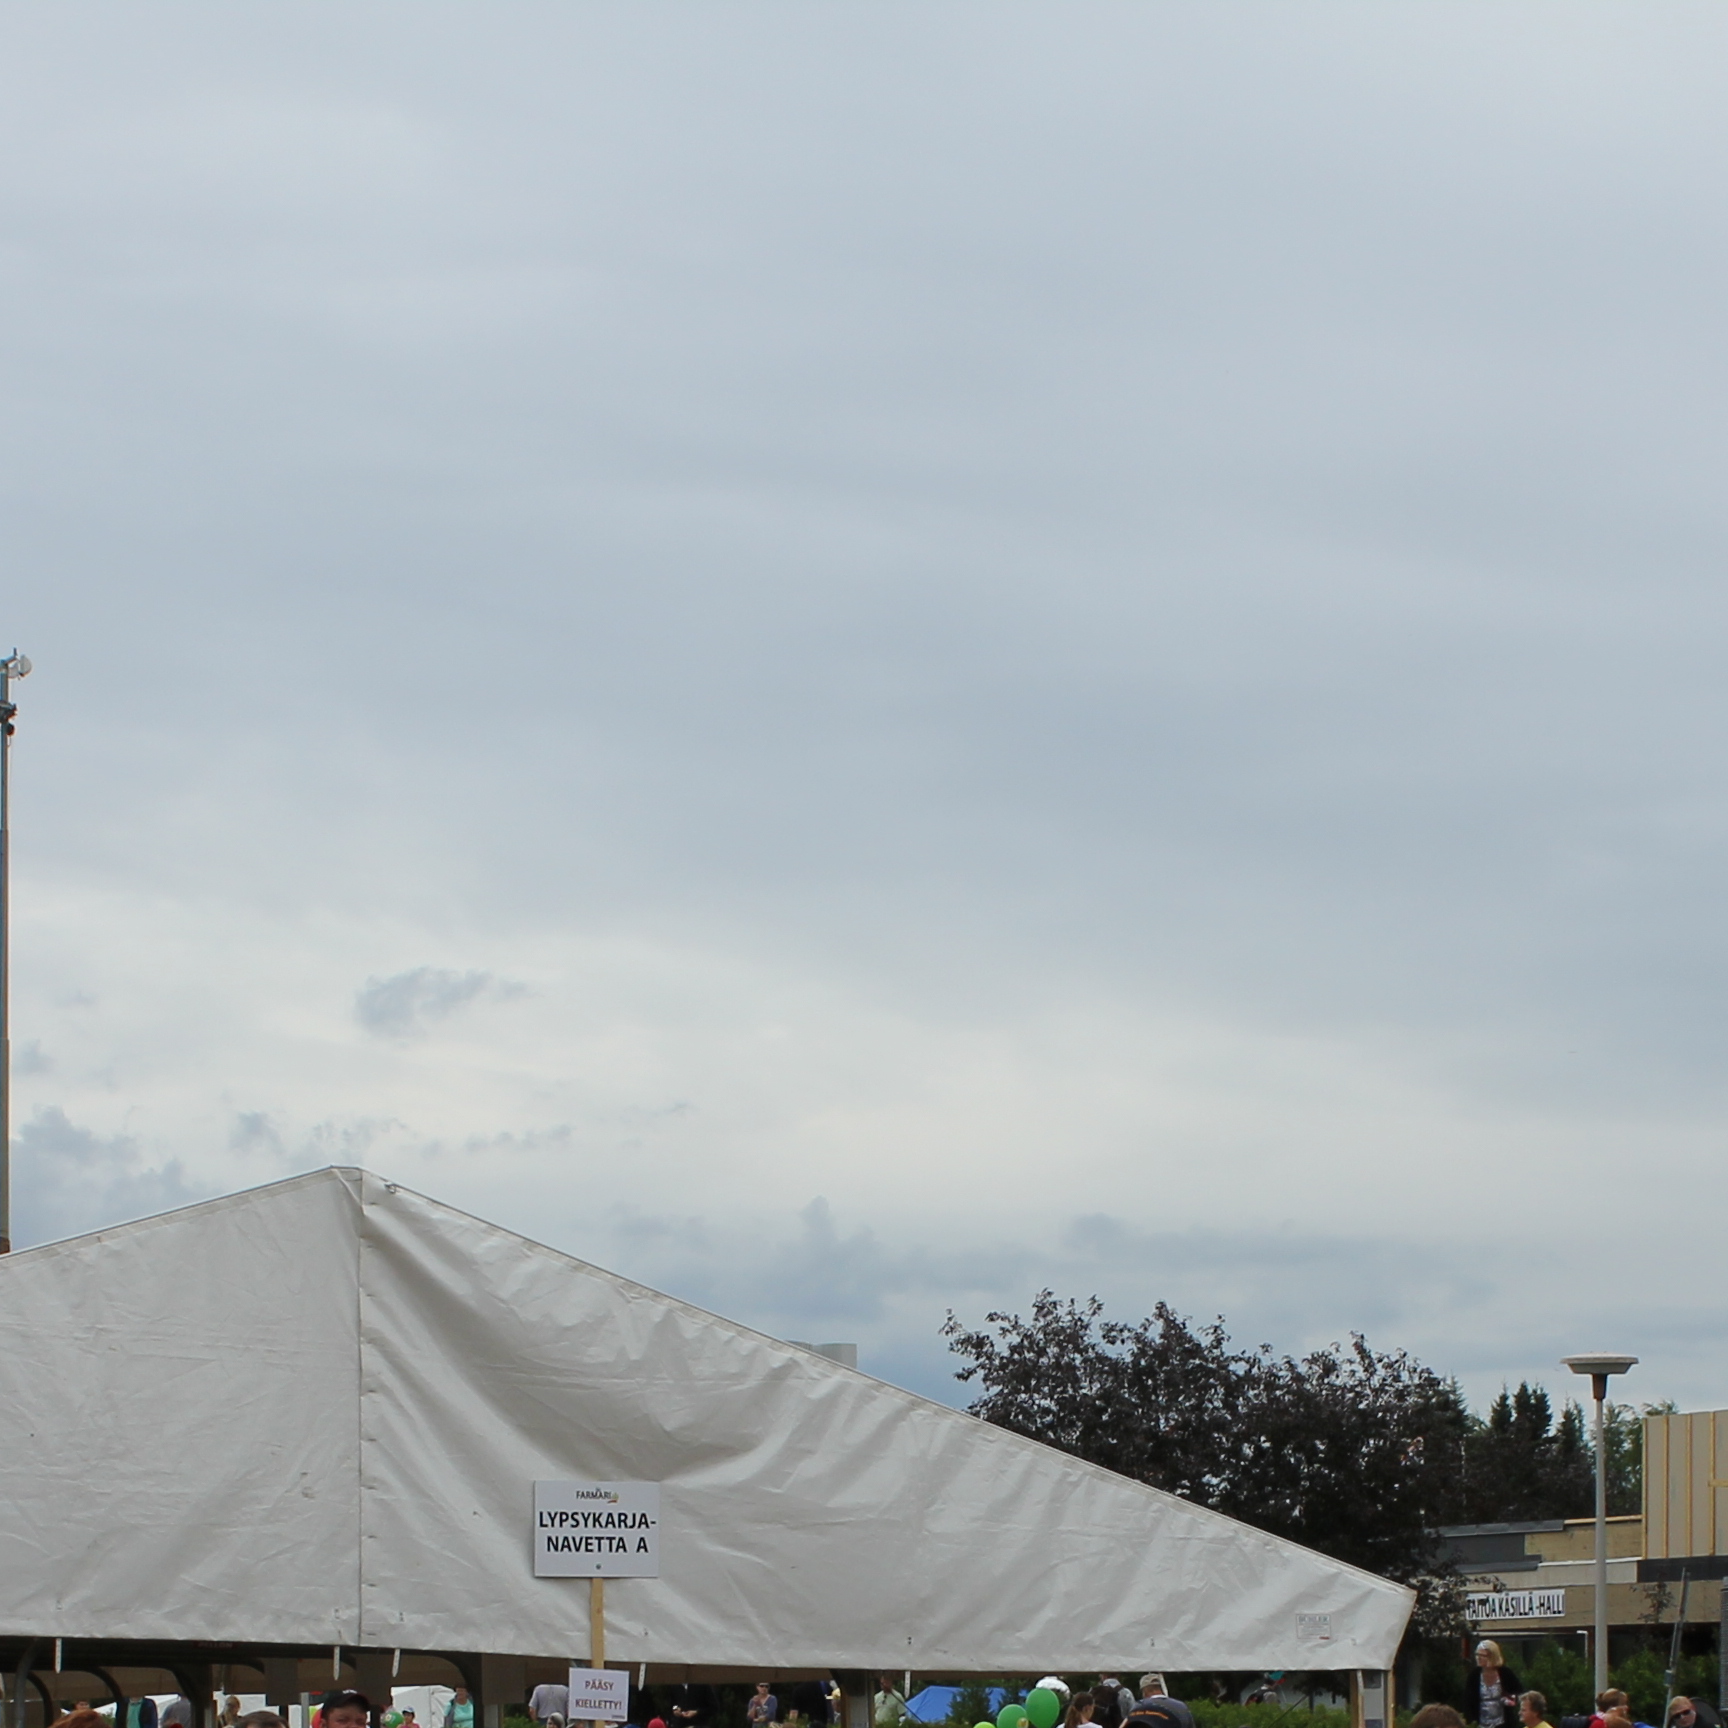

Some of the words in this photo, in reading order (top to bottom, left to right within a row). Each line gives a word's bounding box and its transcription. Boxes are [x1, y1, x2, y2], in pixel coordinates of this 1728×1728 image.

[576, 1487, 611, 1500] FARMÄRI
[539, 1511, 656, 1529] LYPSYKARJA-
[547, 1536, 627, 1553] NAVETTA
[636, 1537, 649, 1553] A
[1499, 1591, 1534, 1617] KÄSILLÄ
[584, 1679, 614, 1690] PÄÄSY
[575, 1699, 622, 1710] KIELLETTY!
